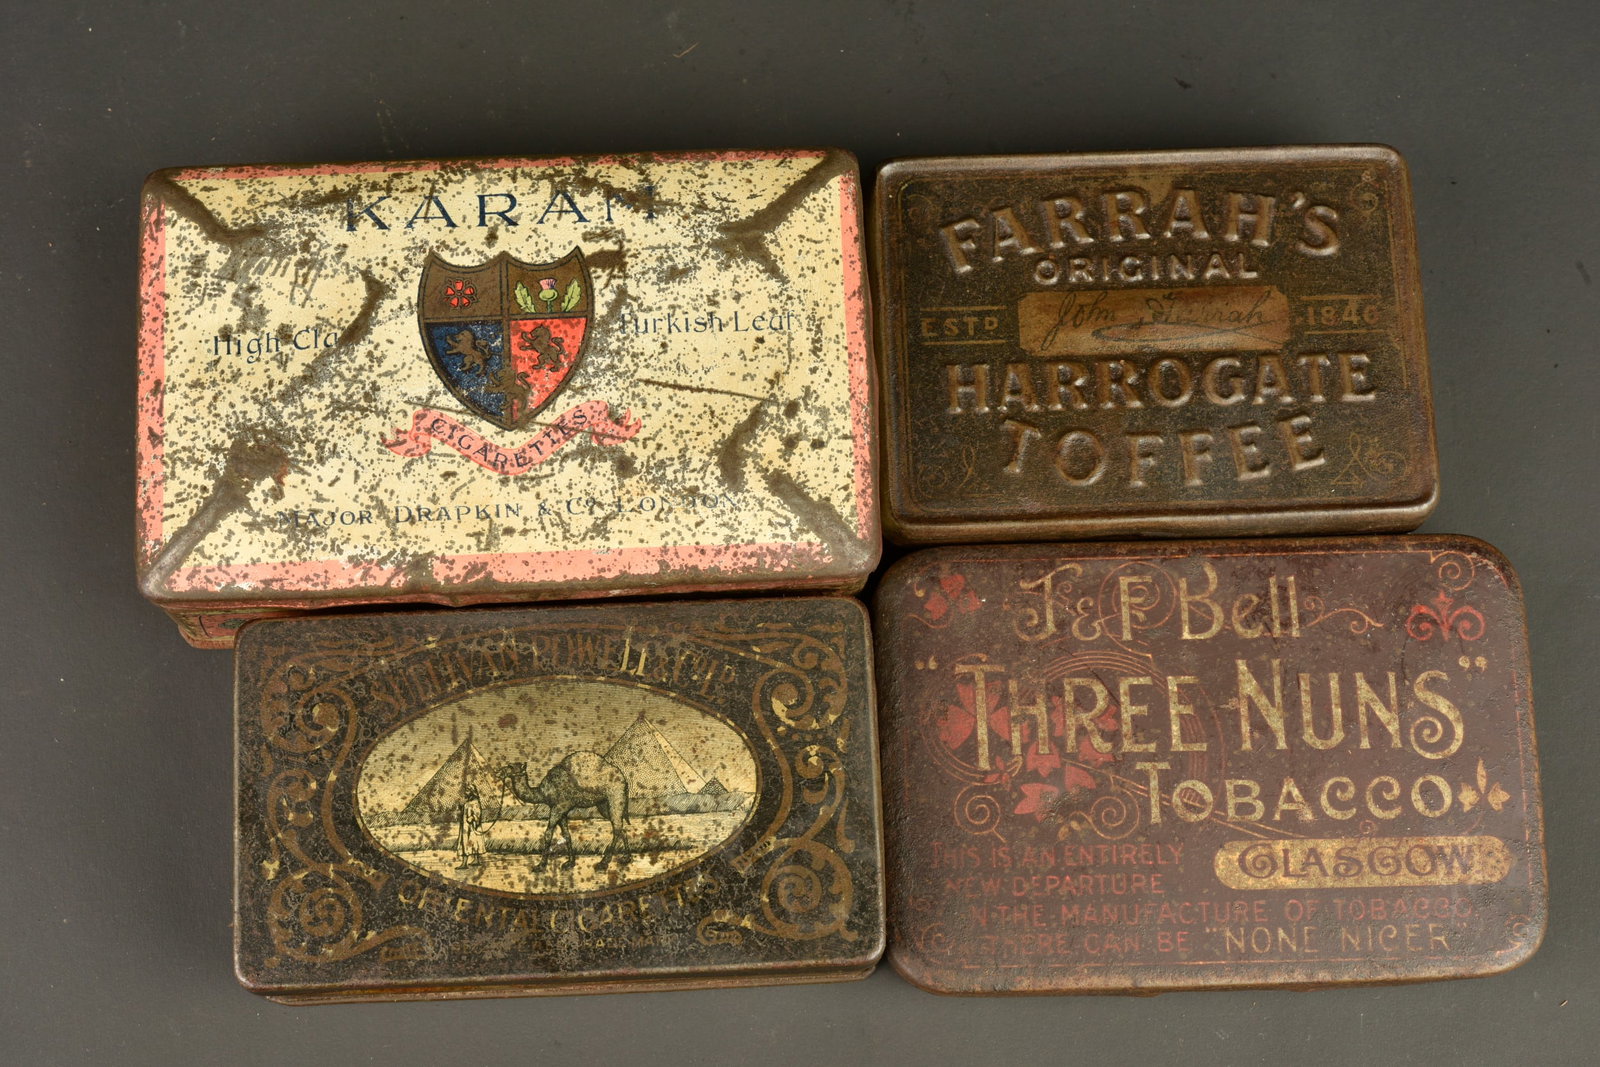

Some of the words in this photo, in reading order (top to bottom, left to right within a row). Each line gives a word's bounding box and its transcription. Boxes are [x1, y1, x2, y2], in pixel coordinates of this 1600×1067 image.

[939, 184, 1340, 275] FARRAH'S
[1033, 252, 1259, 286] ORIGINAL
[733, 309, 795, 332] Leaf
[1041, 290, 1116, 350] John
[213, 331, 281, 364] High
[293, 327, 345, 350] Cla
[946, 352, 1378, 415] HARROGATE
[430, 408, 588, 472] CIGARETTES
[1001, 414, 1326, 489] TOFFEE
[276, 508, 373, 529] MAJOR
[394, 502, 520, 525] DRAPKIN
[538, 499, 552, 517] &
[1177, 560, 1300, 640] Bell
[1135, 760, 1454, 826] TOBACCO
[930, 841, 983, 870] THIS
[992, 845, 1013, 869] IS
[1022, 846, 1056, 869] AN
[1063, 842, 1184, 867] ENTIRELY
[1237, 842, 1474, 880] GLASGOW
[1012, 873, 1166, 898] DEPARTURE
[996, 903, 1047, 928] THE
[1060, 900, 1270, 927] MANUFACTURE
[1284, 898, 1320, 922] OF
[1083, 931, 1141, 954] CAN
[1156, 930, 1192, 953] BE
